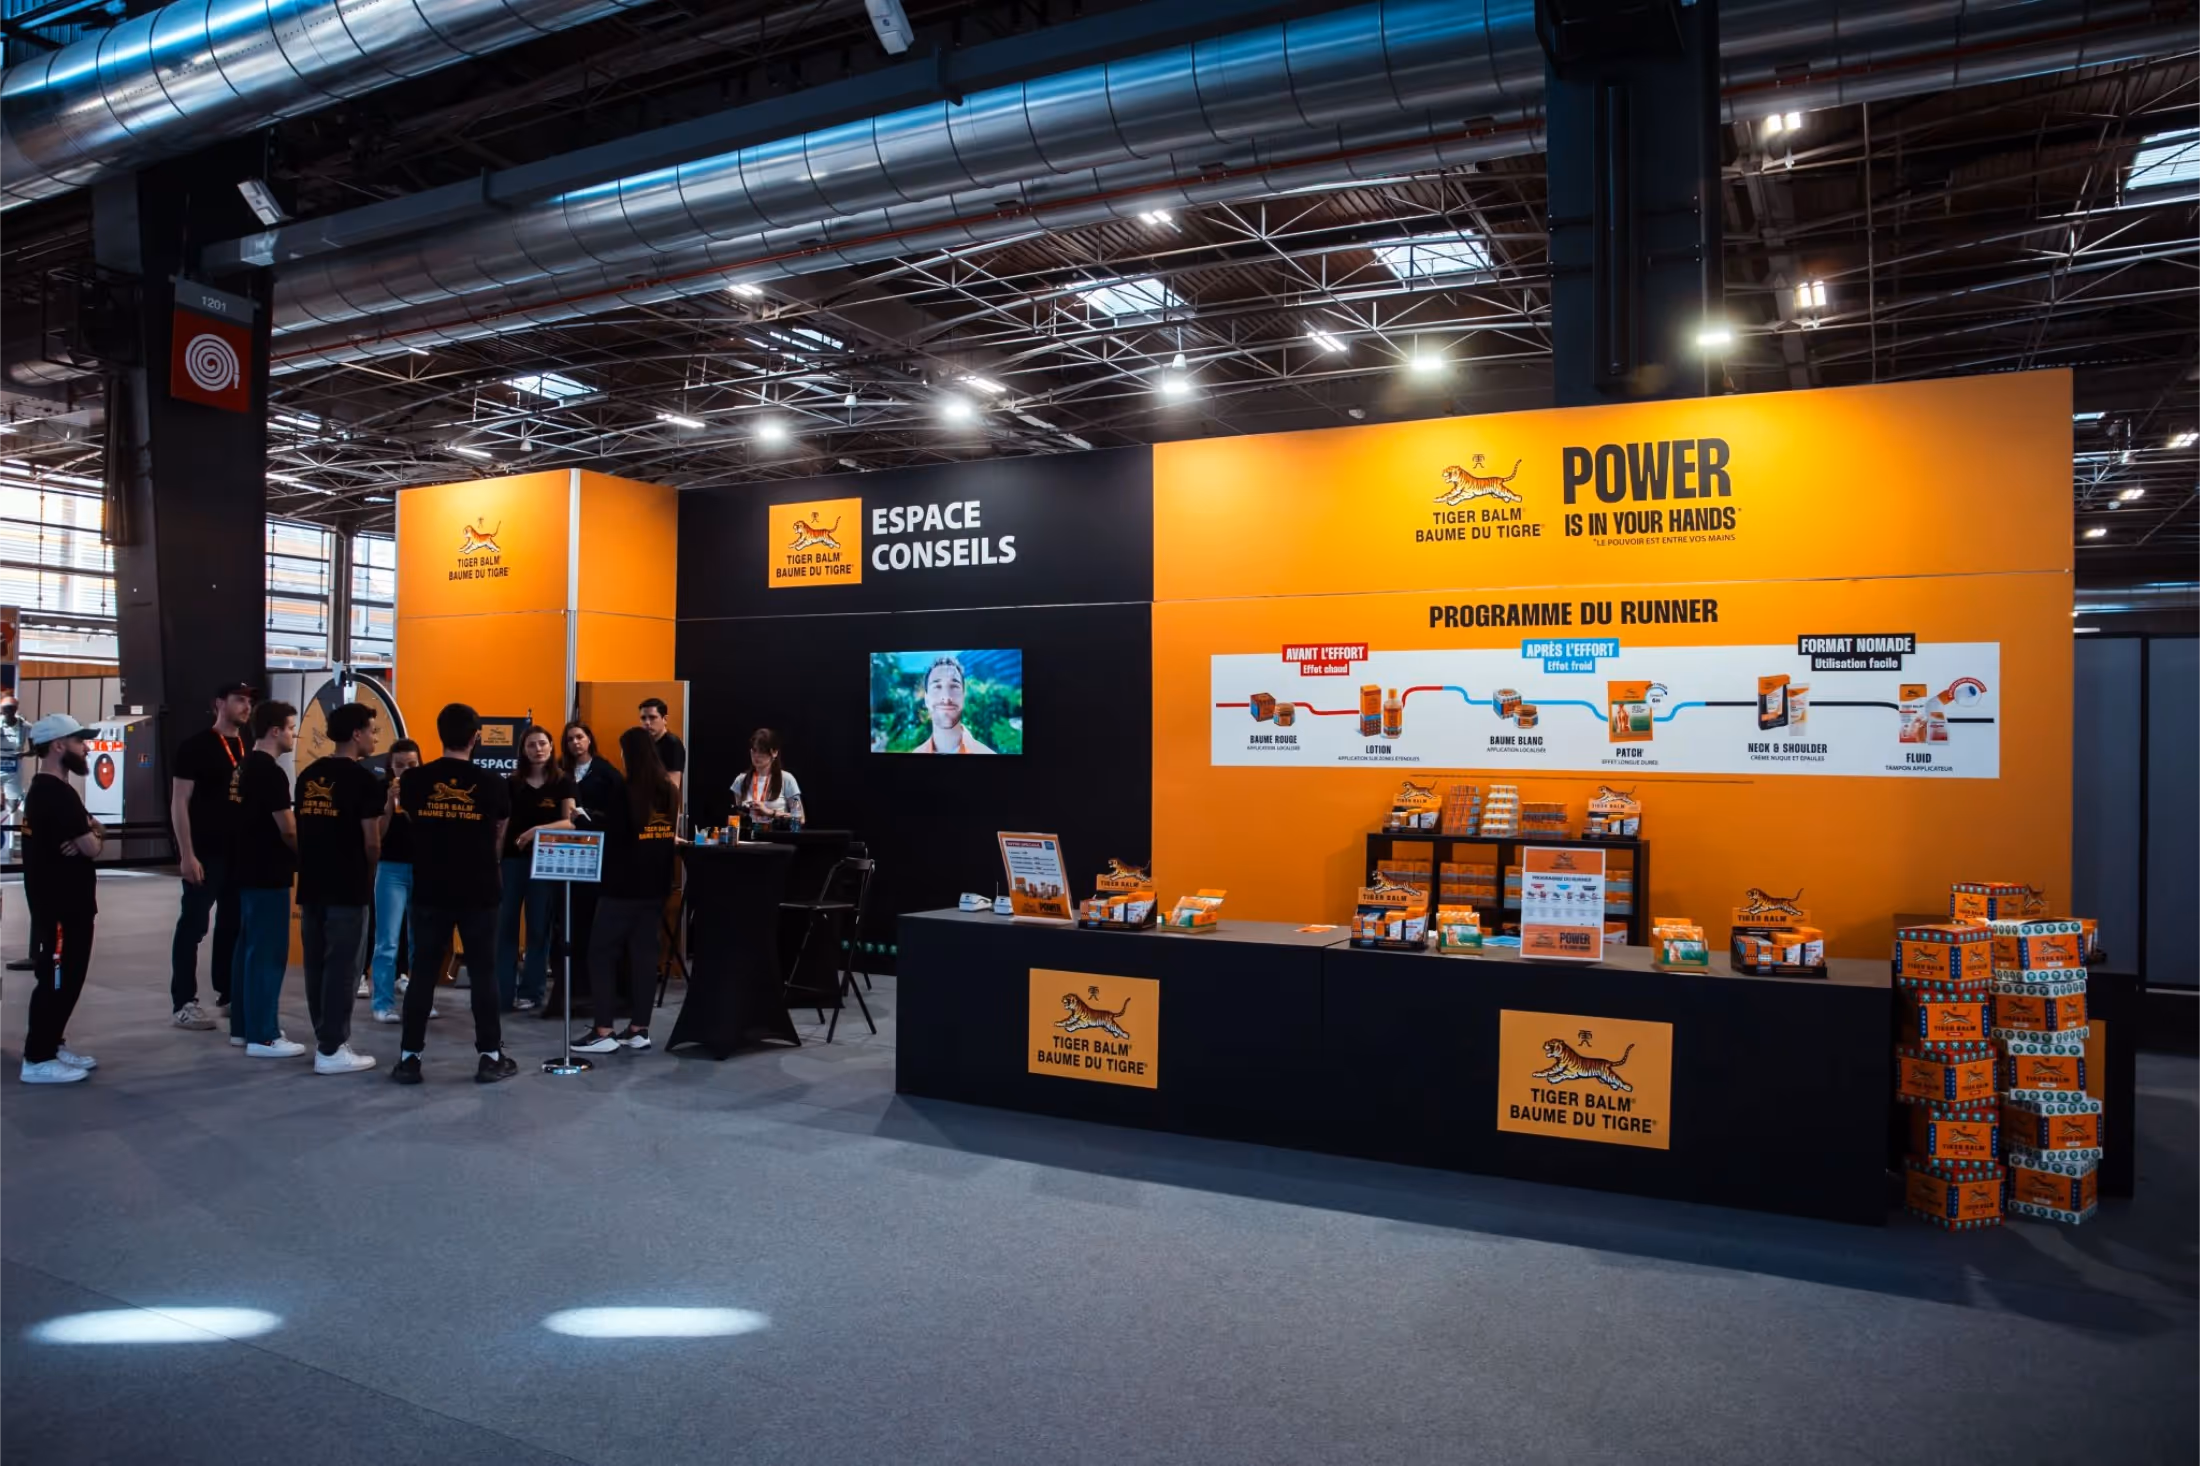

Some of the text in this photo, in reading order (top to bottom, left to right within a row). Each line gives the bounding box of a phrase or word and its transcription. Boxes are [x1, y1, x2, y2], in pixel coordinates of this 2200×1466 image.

[202, 296, 227, 312] 1201
[1562, 437, 1732, 505] POWER
[872, 500, 982, 535] ESPACE
[1433, 510, 1476, 525] TIGER
[1565, 513, 1583, 537] IS
[1589, 512, 1608, 536] IN
[1613, 510, 1663, 535] YOUR
[1416, 527, 1466, 543] BAUME
[1472, 526, 1491, 540] DU
[1608, 537, 1644, 547] POUVOIR
[1646, 537, 1660, 545] EST
[1662, 536, 1687, 545] ENTRE
[1690, 535, 1705, 543] VOS
[1708, 533, 1736, 542] MAINS
[787, 554, 812, 565] TIGER
[872, 535, 1017, 571] CONSEILS
[457, 557, 478, 568] TIGER
[449, 569, 473, 581] BAUME
[475, 569, 485, 579] DU
[776, 566, 806, 578] BAUME
[810, 566, 822, 577] DU
[1429, 599, 1719, 628] PROGRAMME DU RUNNER
[1526, 641, 1615, 657] APRÈS L'EFFORT
[1801, 637, 1911, 654] FORMAT NOMADE
[1286, 646, 1365, 661] AVANT L'EFFORT
[1303, 664, 1348, 674] Effet chaud
[1547, 660, 1593, 671] Effet froid
[1815, 656, 1898, 669] Utilisation facile
[1250, 734, 1297, 744] BAUME ROUGE
[1490, 736, 1543, 746] BAUME BLANC
[1366, 745, 1391, 754] LOTION
[1748, 743, 1828, 754] NECK & SHOULDER
[1906, 753, 1932, 763] FLUID
[427, 802, 449, 810] TIGER
[1738, 914, 1761, 922] TIGER
[1559, 932, 1591, 945] POWER
[1053, 1035, 1089, 1051] TIGER
[1038, 1050, 1080, 1067] BAUME
[1085, 1055, 1102, 1069] DU
[1530, 1087, 1579, 1106] TIGER
[1510, 1104, 1566, 1124] BAUME
[1573, 1110, 1595, 1127] DU
